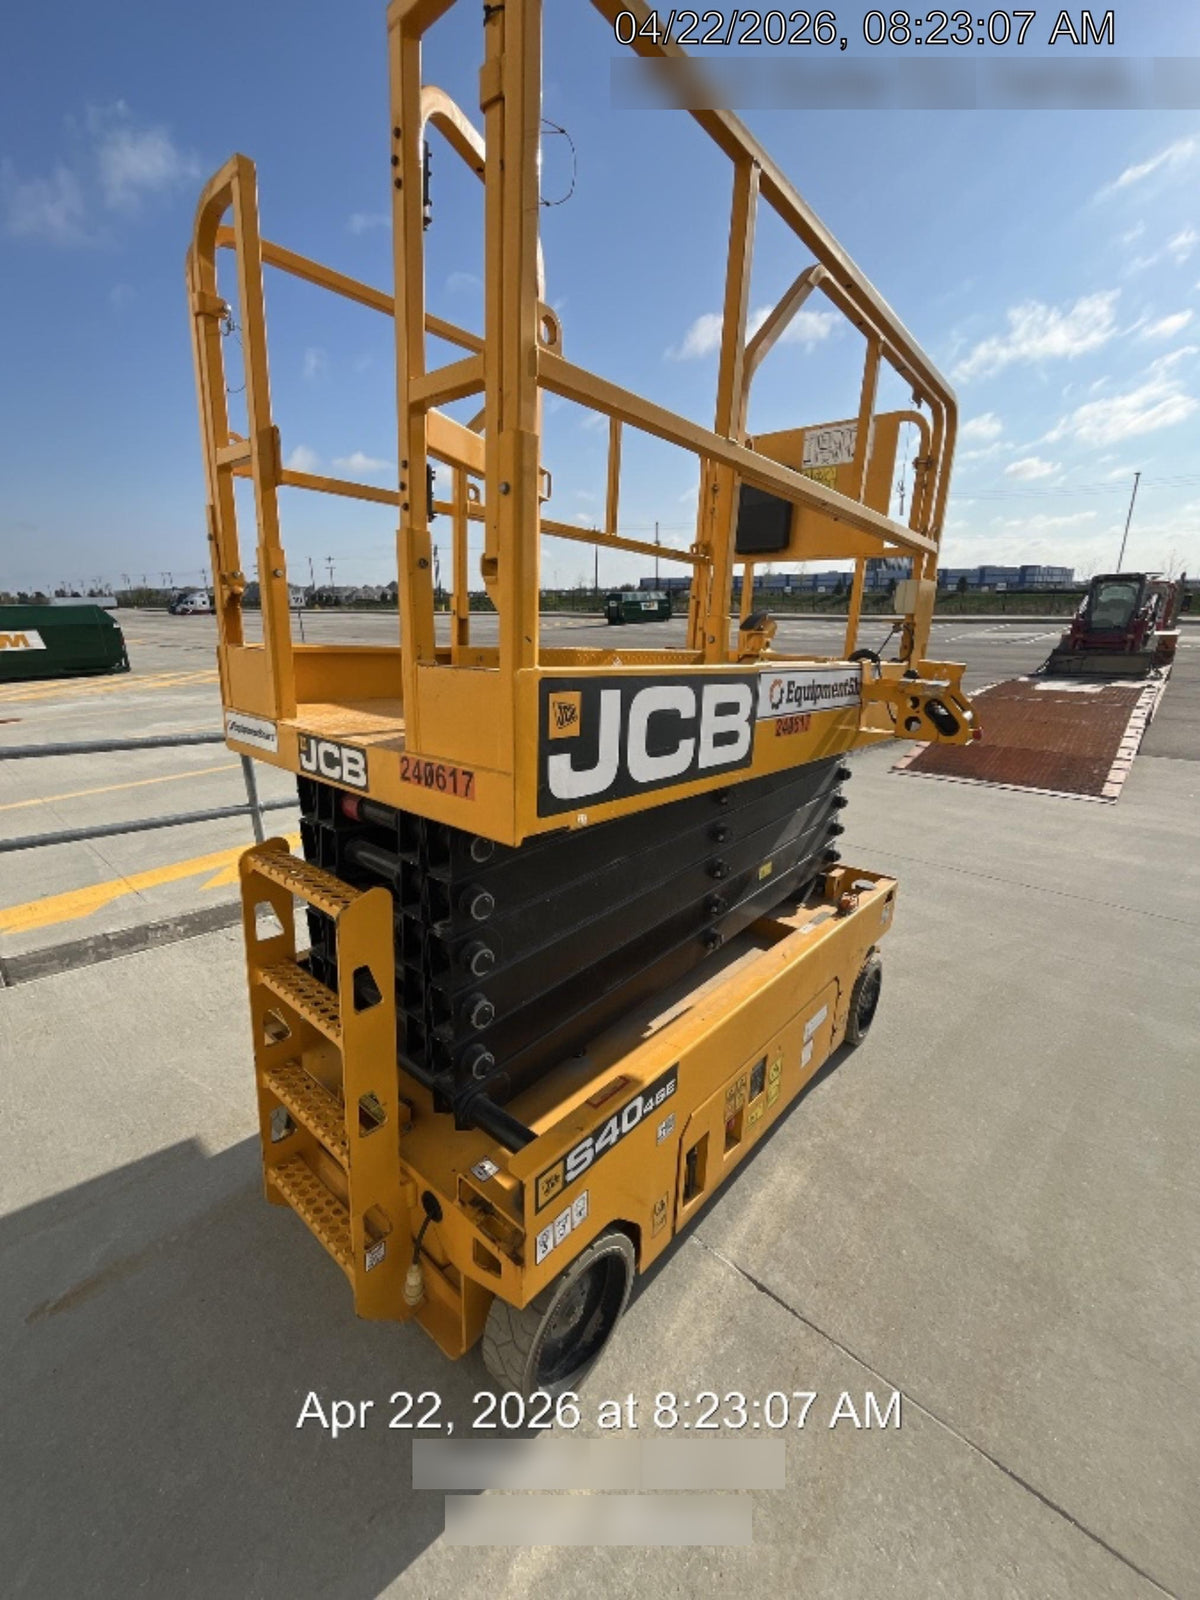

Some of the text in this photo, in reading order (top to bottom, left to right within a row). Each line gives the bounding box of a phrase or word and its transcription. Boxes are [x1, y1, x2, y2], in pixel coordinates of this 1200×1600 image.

[301, 739, 367, 787] JCB
[548, 684, 752, 800] JCB
[400, 756, 474, 797] 240617
